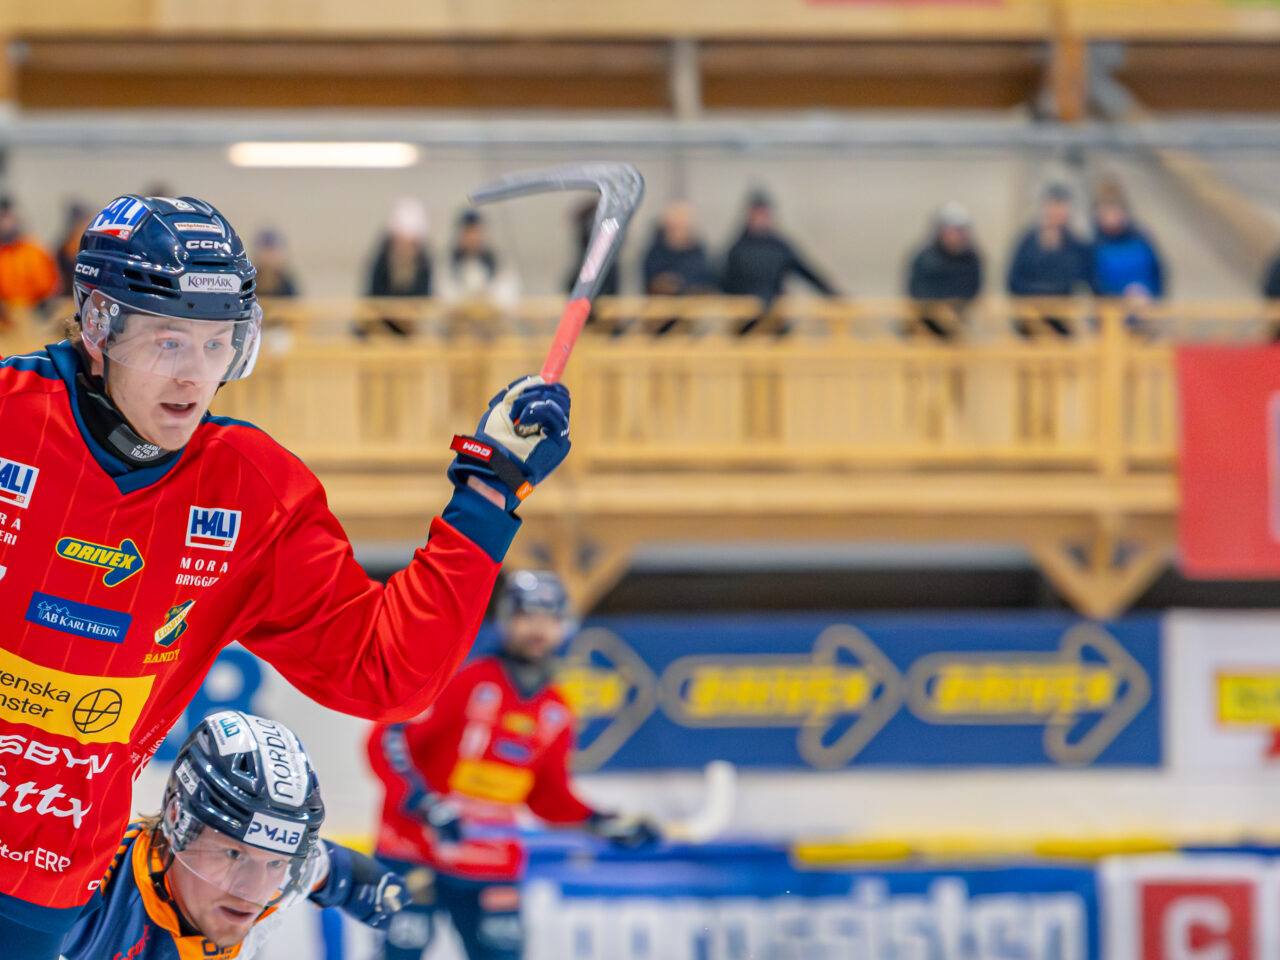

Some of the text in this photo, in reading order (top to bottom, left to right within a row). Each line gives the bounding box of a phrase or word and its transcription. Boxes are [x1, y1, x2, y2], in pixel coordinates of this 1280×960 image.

[185, 239, 232, 255] CCM
[75, 263, 100, 278] CCM
[191, 509, 237, 539] HALI
[62, 541, 138, 570] DRIVEX
[180, 557, 228, 574] MORA
[175, 573, 220, 587] BRYGGE
[42, 610, 120, 638] AB KARL HEDIN
[143, 648, 181, 664] BANDY
